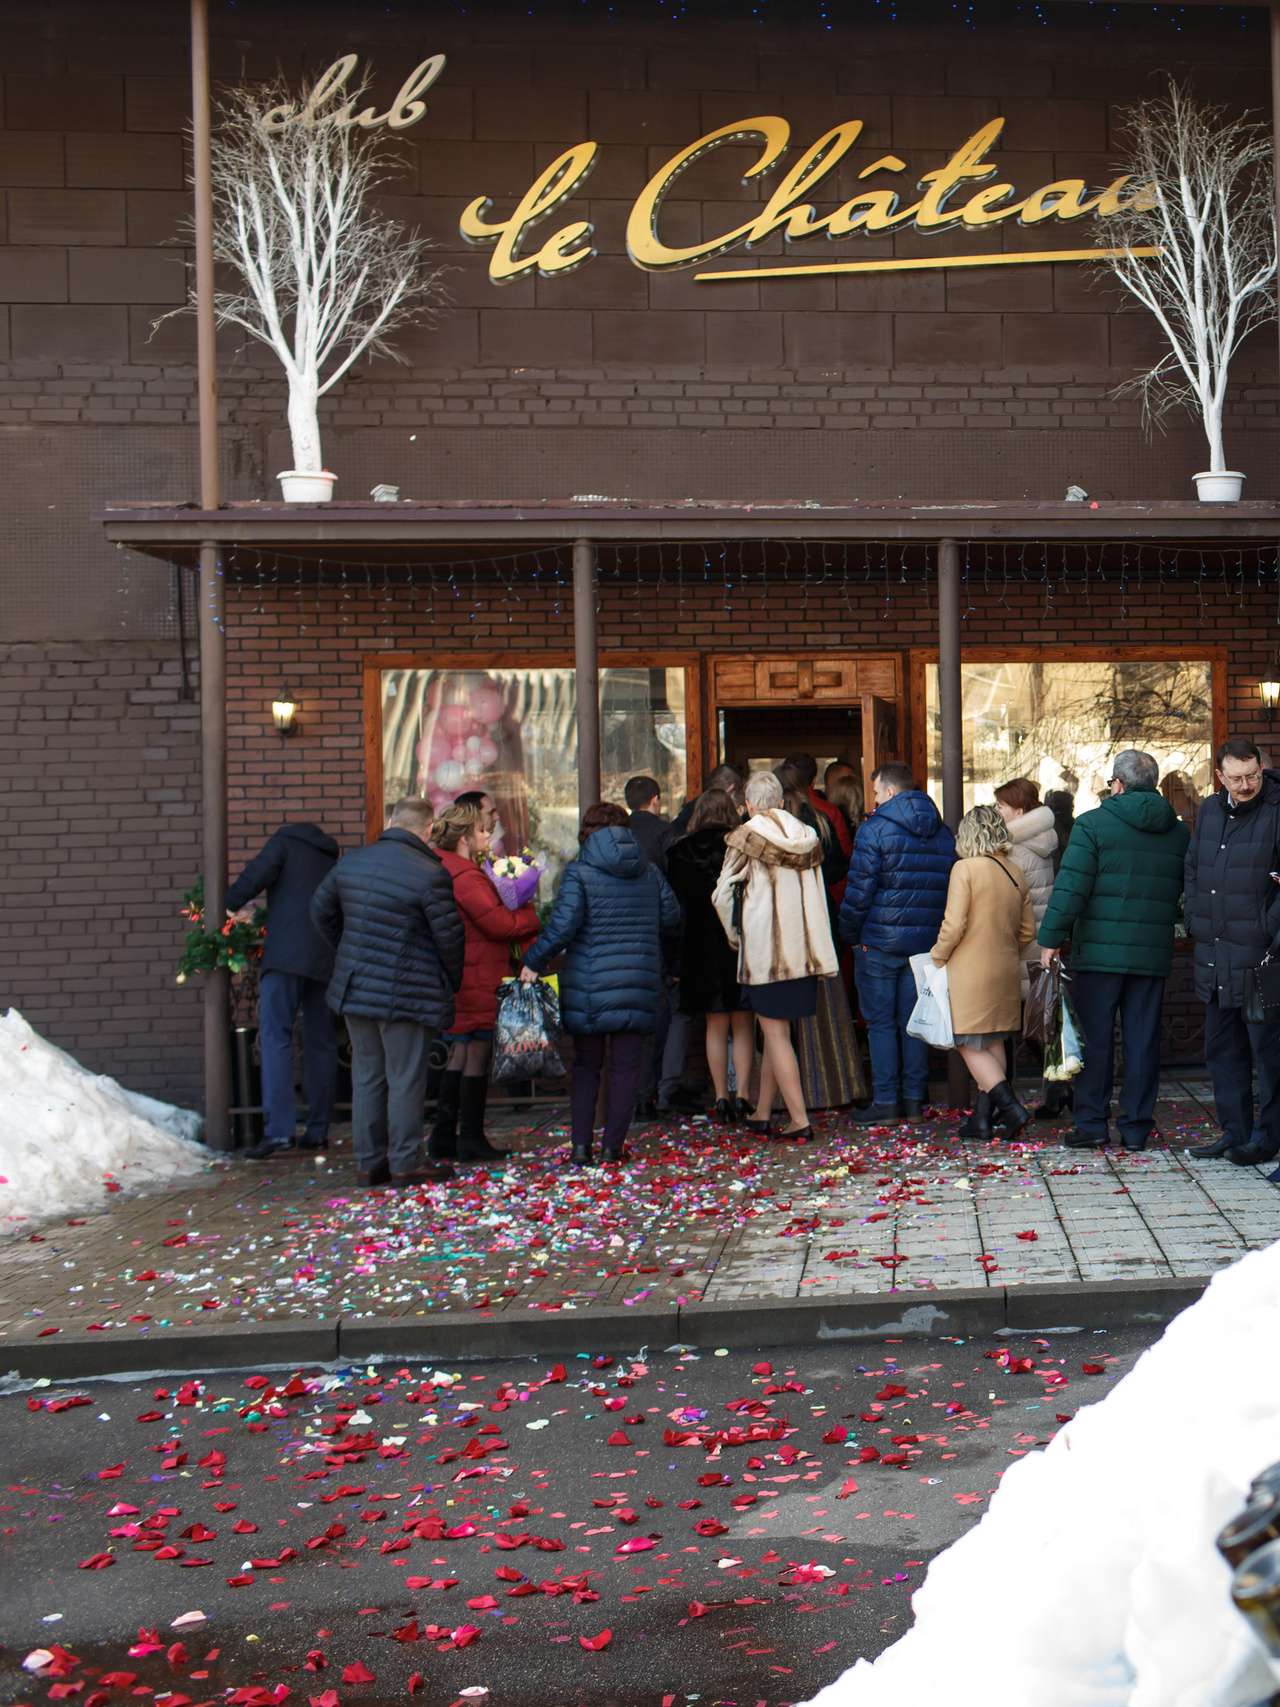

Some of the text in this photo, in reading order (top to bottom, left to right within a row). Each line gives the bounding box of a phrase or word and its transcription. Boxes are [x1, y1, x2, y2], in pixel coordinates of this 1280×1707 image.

[261, 54, 446, 131] club
[460, 115, 1163, 285] le Château
